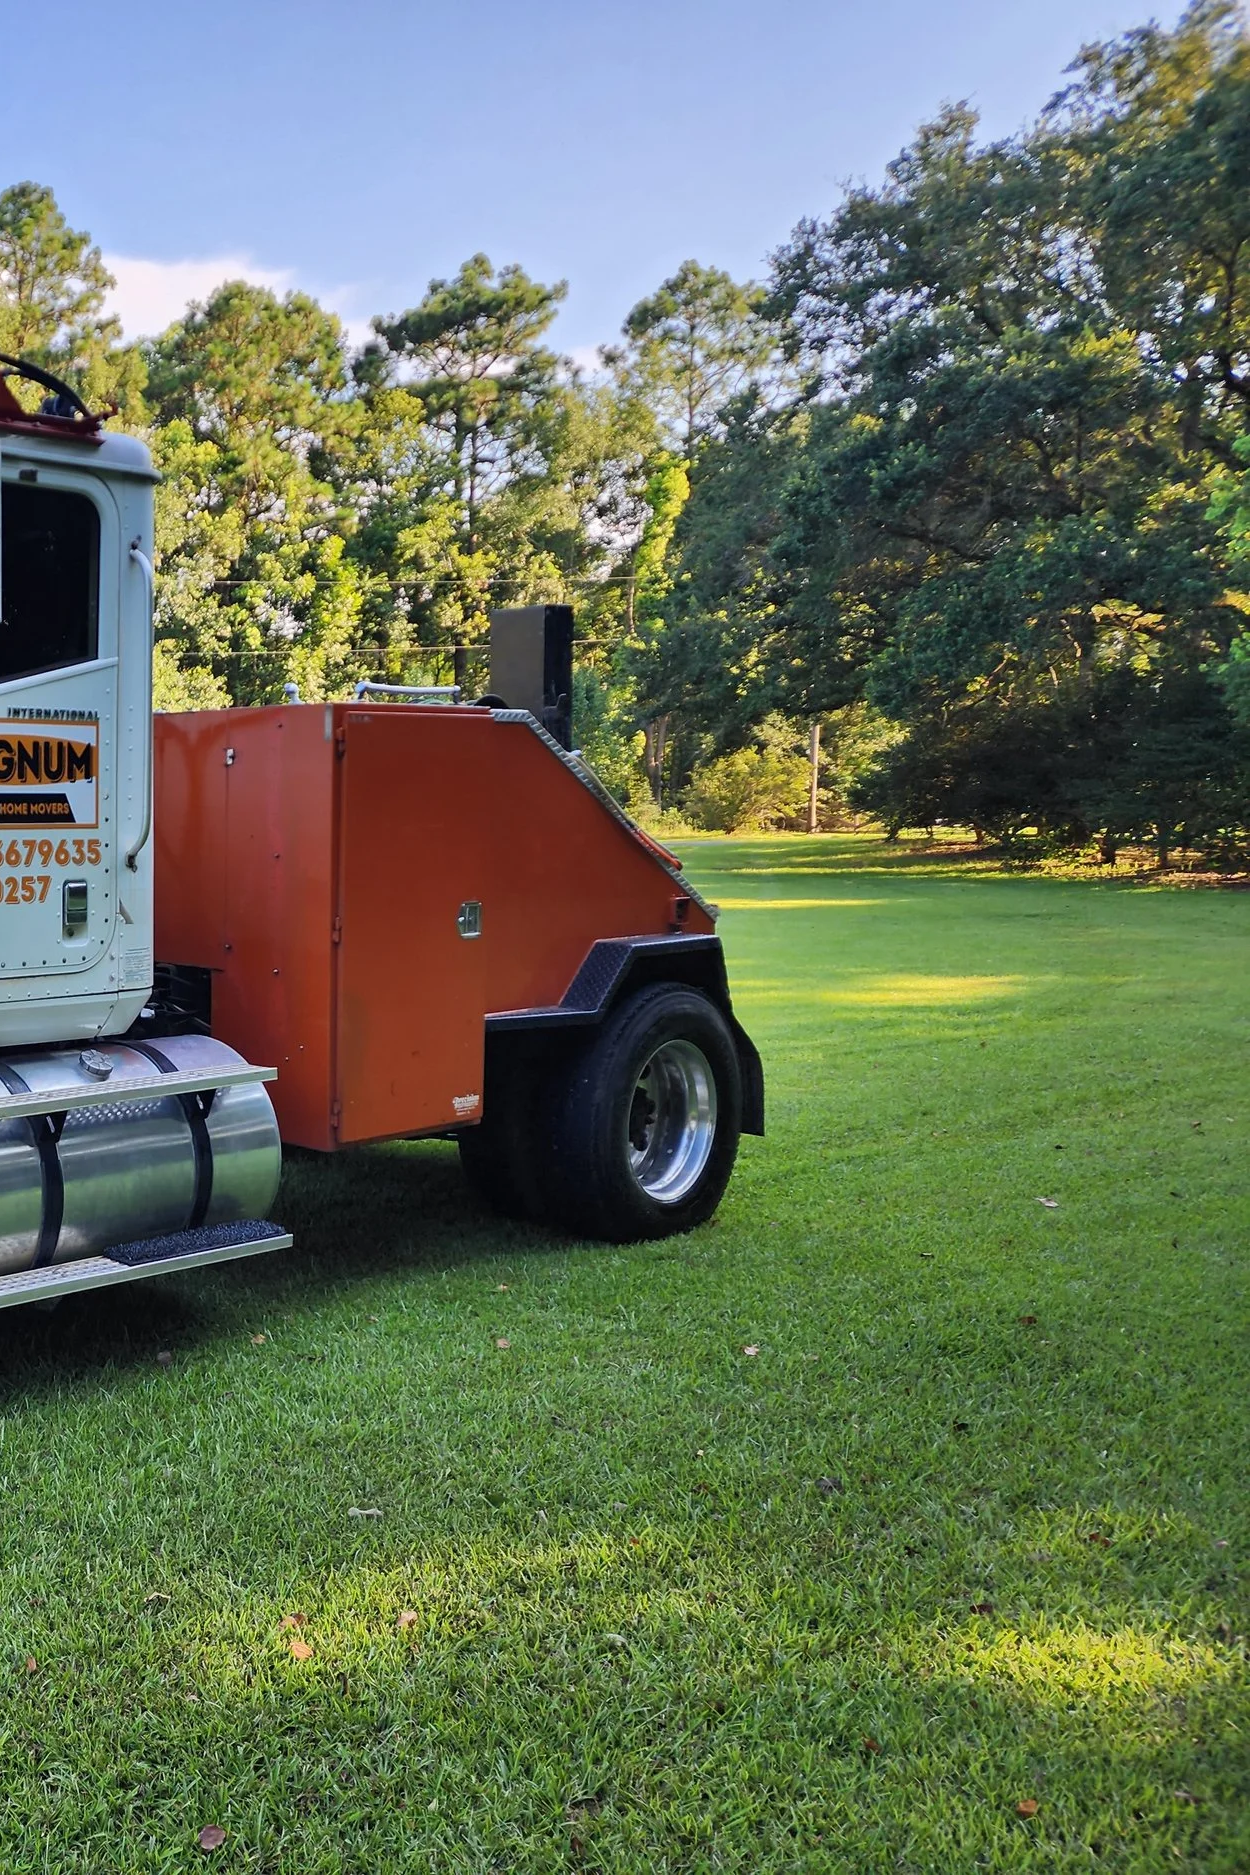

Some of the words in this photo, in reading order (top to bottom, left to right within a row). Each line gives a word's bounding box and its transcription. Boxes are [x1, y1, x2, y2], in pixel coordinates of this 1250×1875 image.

[8, 707, 99, 721] INTERNATIONAL
[0, 803, 28, 815] HOME
[30, 803, 69, 815] MOVERS
